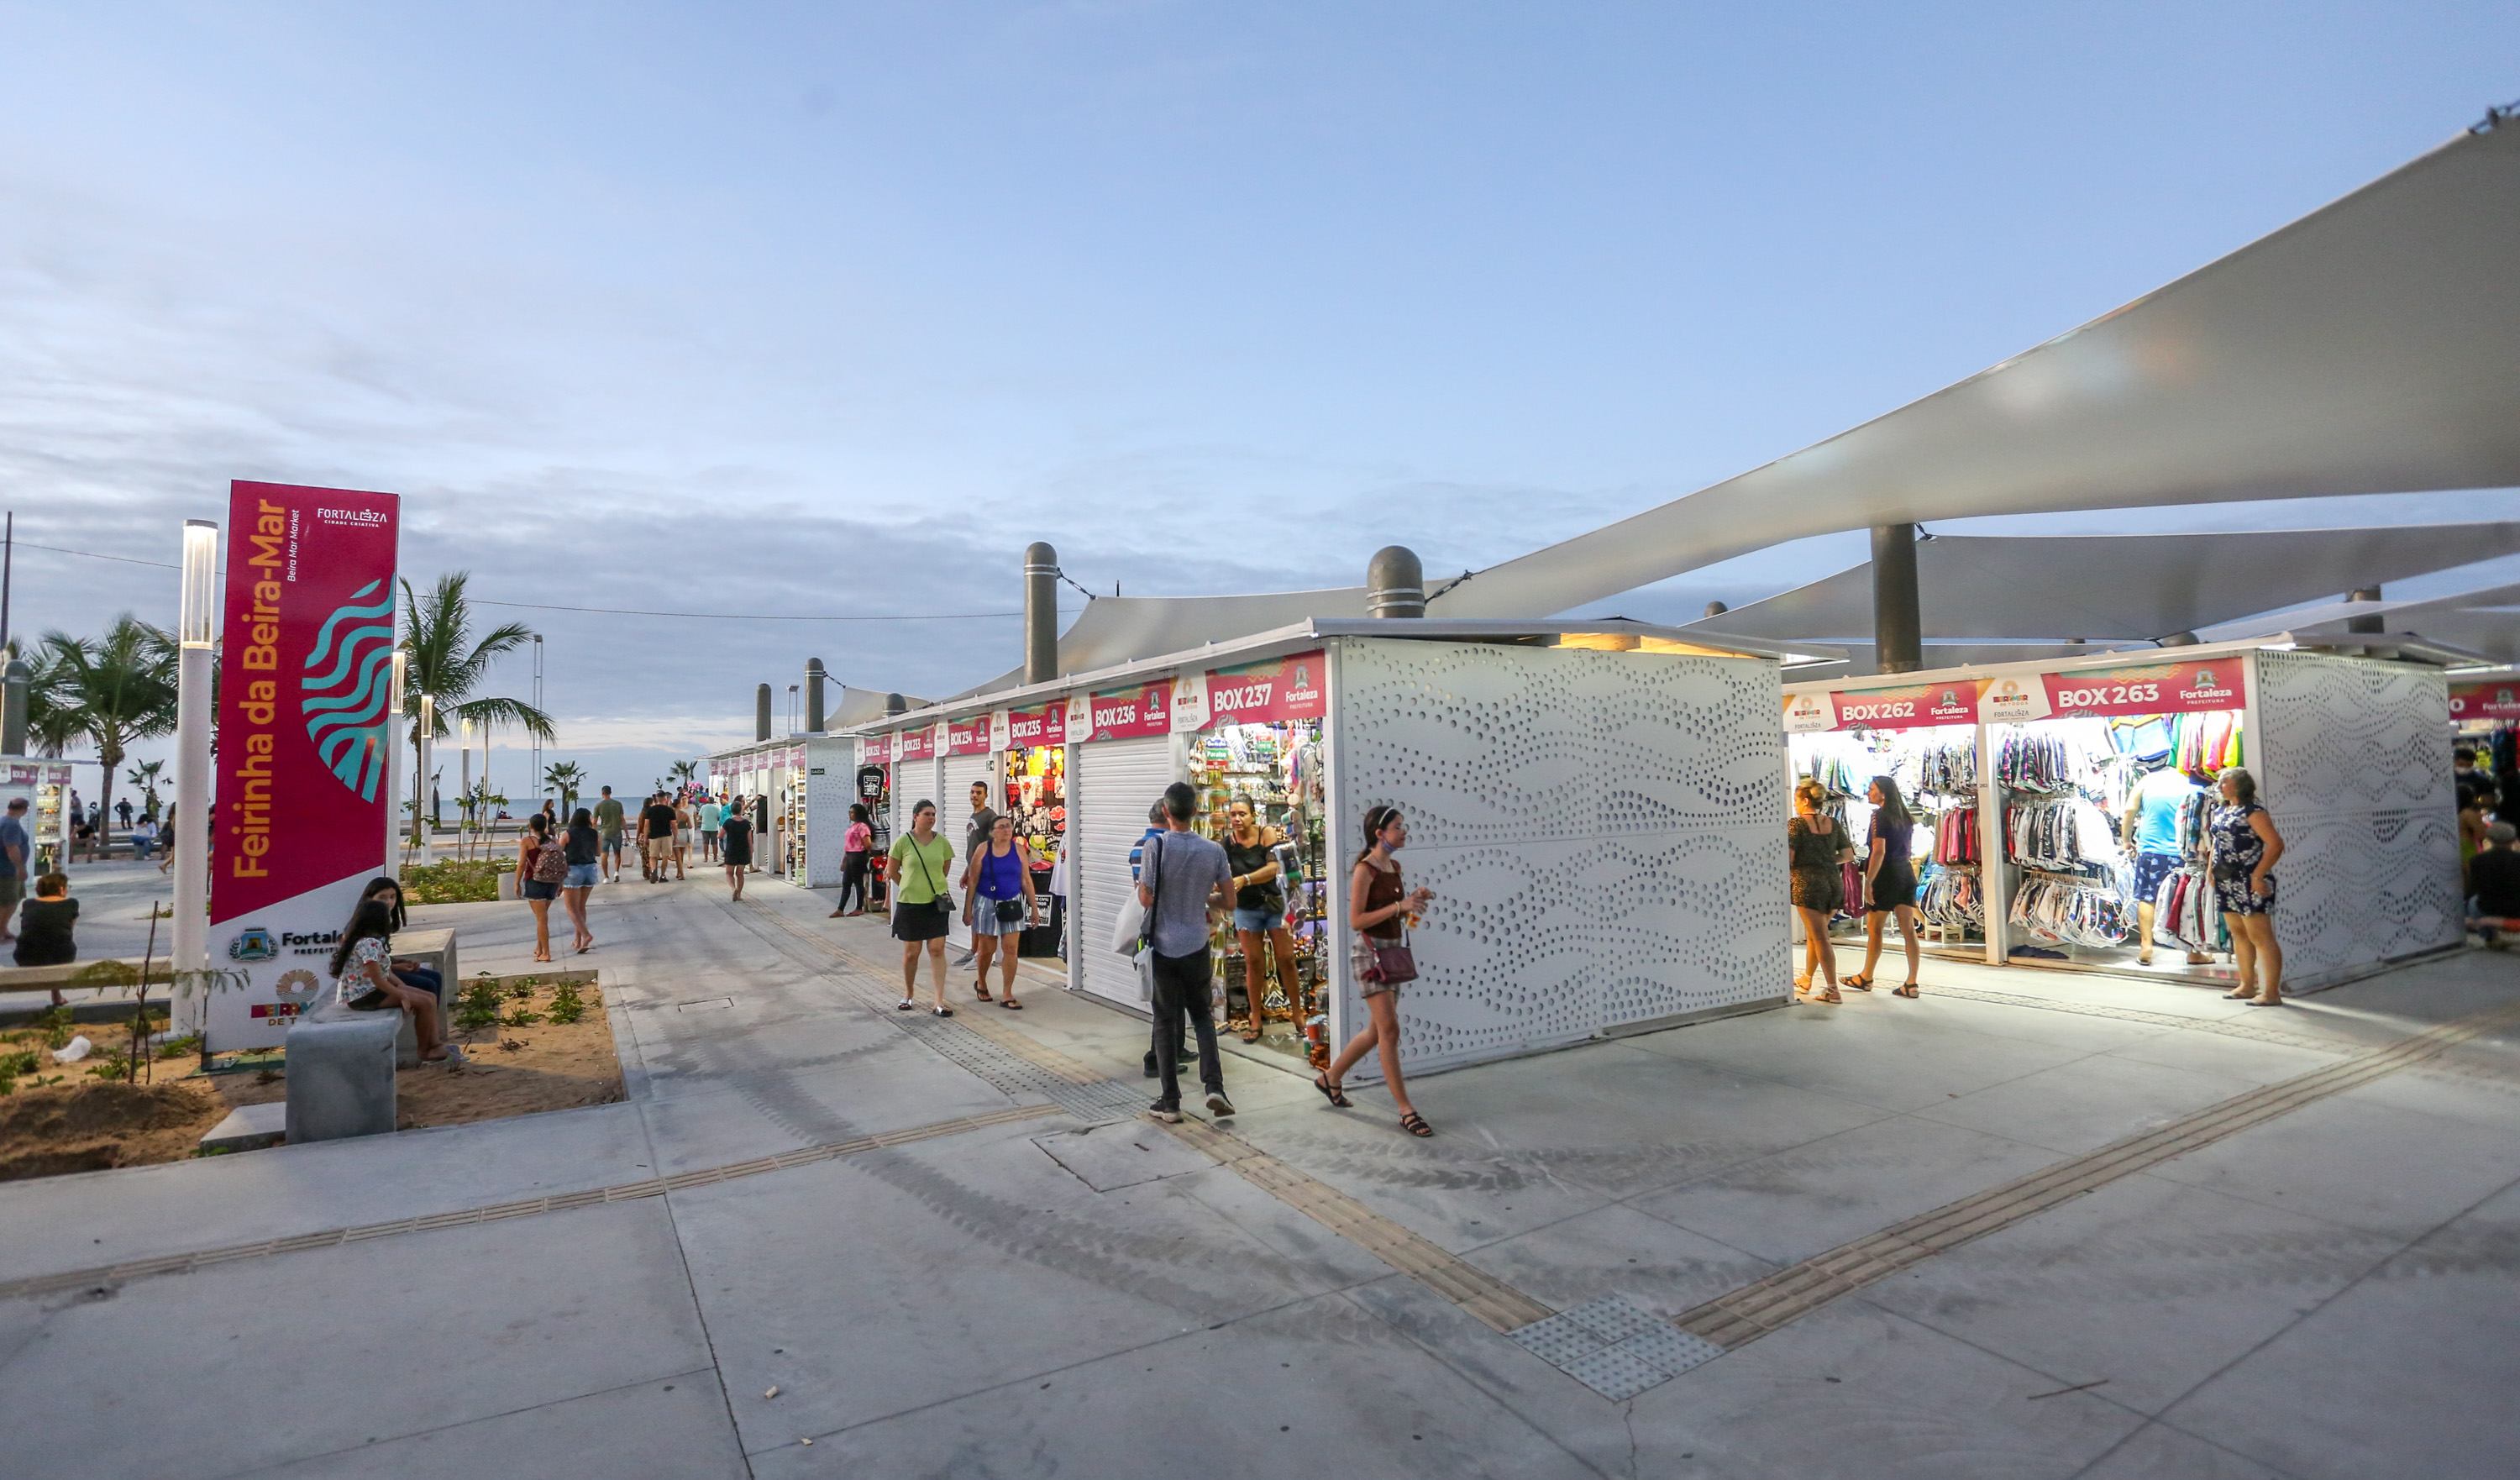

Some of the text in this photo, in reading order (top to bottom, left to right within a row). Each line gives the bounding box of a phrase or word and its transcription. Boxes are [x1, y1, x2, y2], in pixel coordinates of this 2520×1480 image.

[287, 509, 299, 581] Beira Mar Market
[231, 498, 286, 878] Feirinha da Beira-Mar
[1285, 689, 1318, 703] Fortaleza
[2058, 684, 2160, 708] BOX 263
[2180, 688, 2232, 700] Fortaleza
[1215, 683, 1273, 712] BOX 237
[1095, 705, 1136, 727] BOX 236
[1144, 711, 1166, 721] Fortaleza
[1842, 702, 1915, 722] BOX 262
[1930, 706, 1969, 716] Fortaleza
[1011, 722, 1028, 738] BOX
[1027, 720, 1041, 736] 235
[904, 738, 921, 752] BOX 233
[950, 731, 973, 746] BOX 234
[282, 930, 343, 947] Fortal
[294, 947, 335, 955] PREFEIT
[268, 1018, 285, 1026] DE
